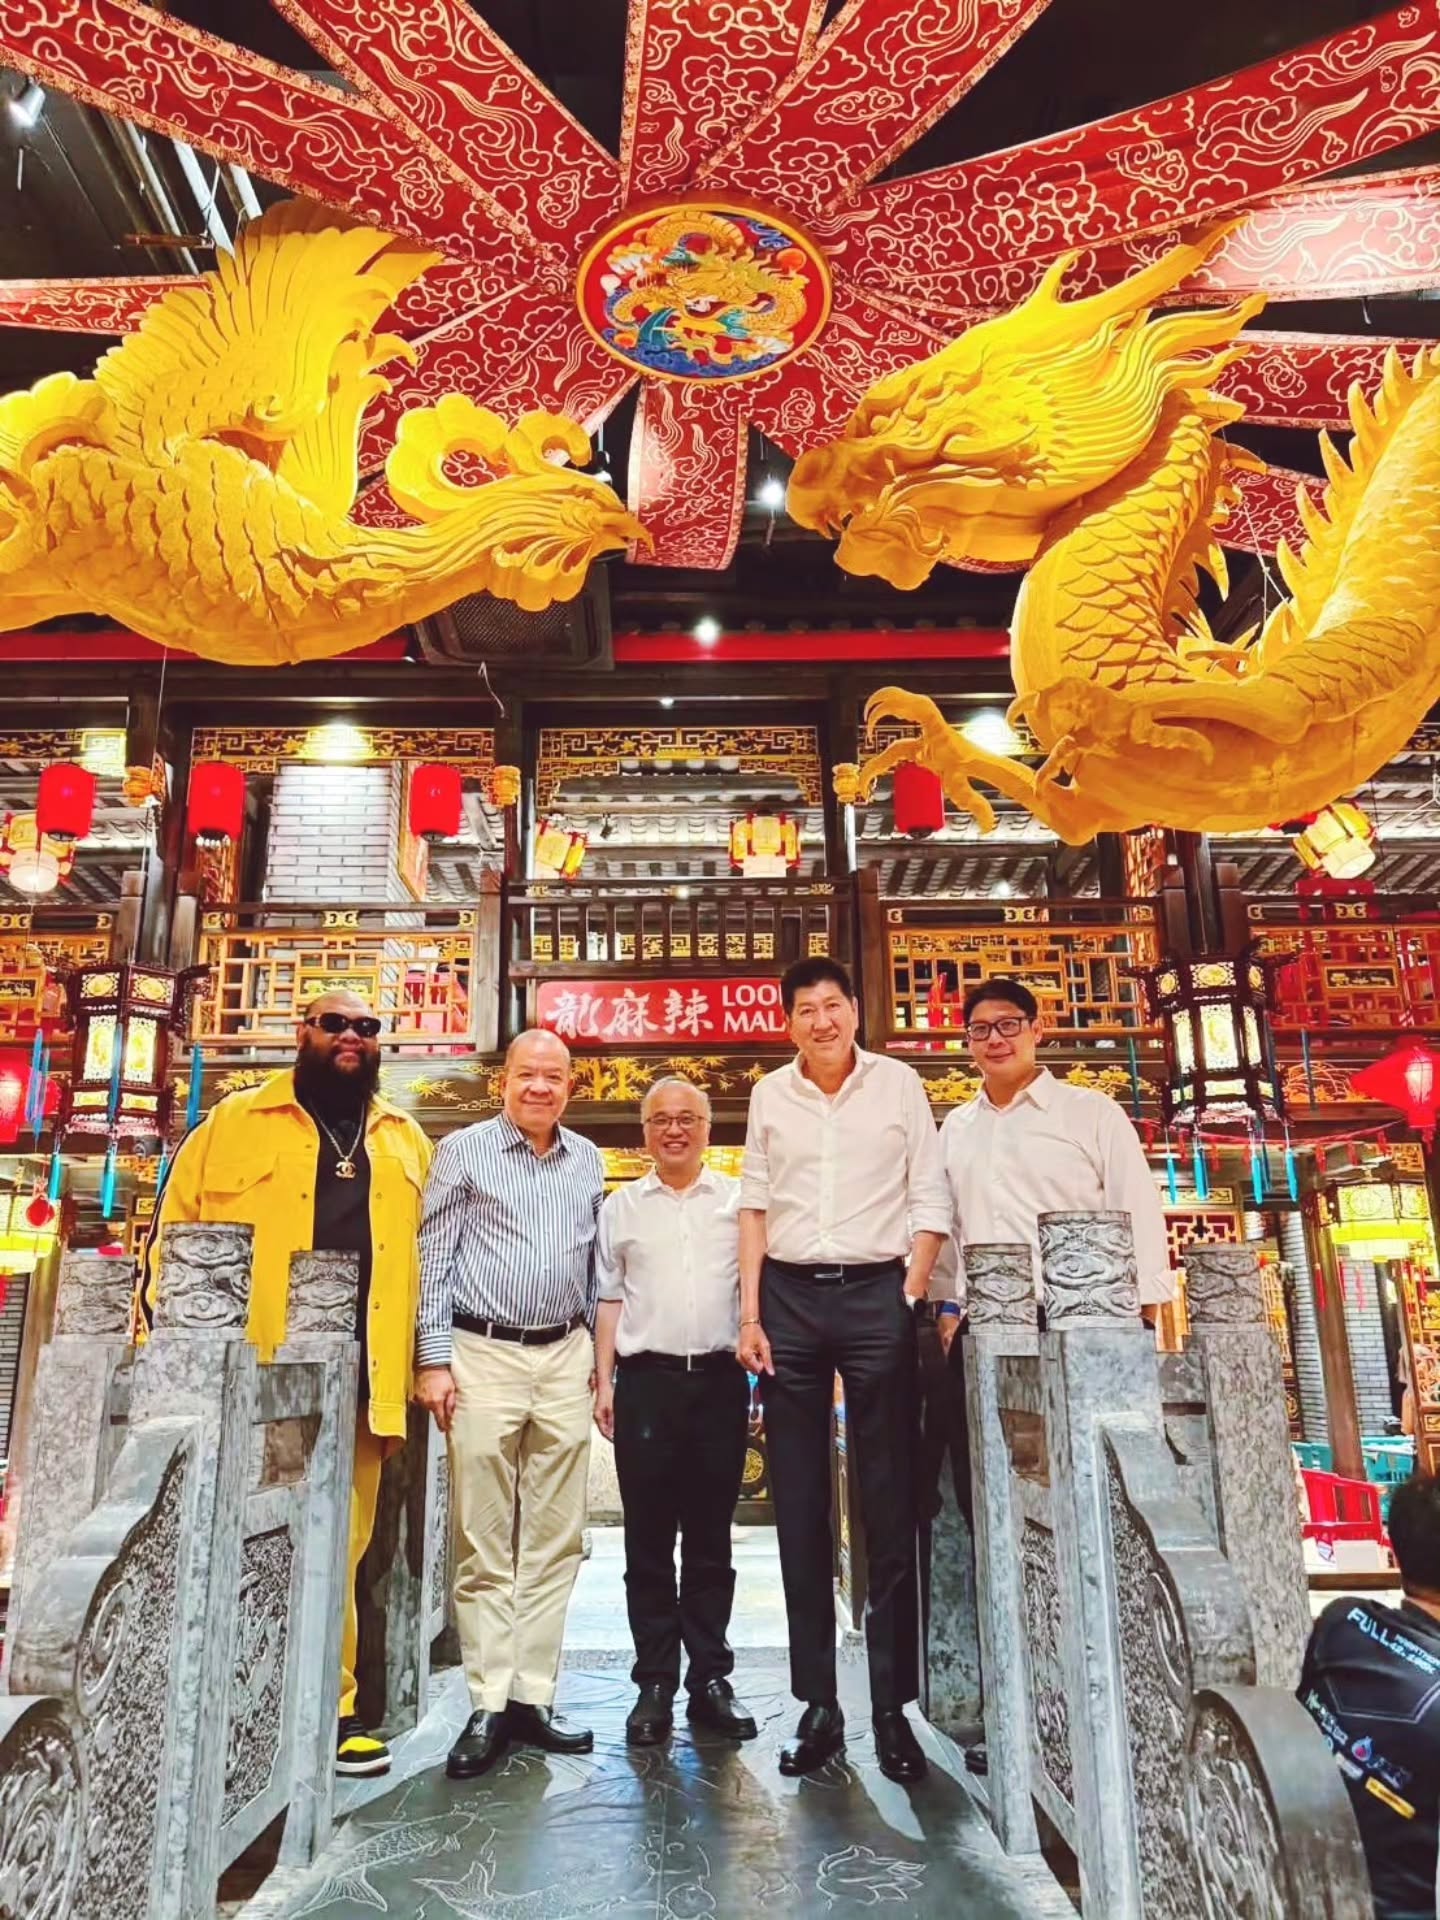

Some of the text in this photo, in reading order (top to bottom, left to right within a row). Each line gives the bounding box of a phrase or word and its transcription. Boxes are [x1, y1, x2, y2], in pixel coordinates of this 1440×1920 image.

[722, 984, 783, 1007] LOO
[544, 988, 714, 1039] 龍麻辣
[723, 1010, 787, 1033] MAL
[1346, 1607, 1389, 1648] FULL
